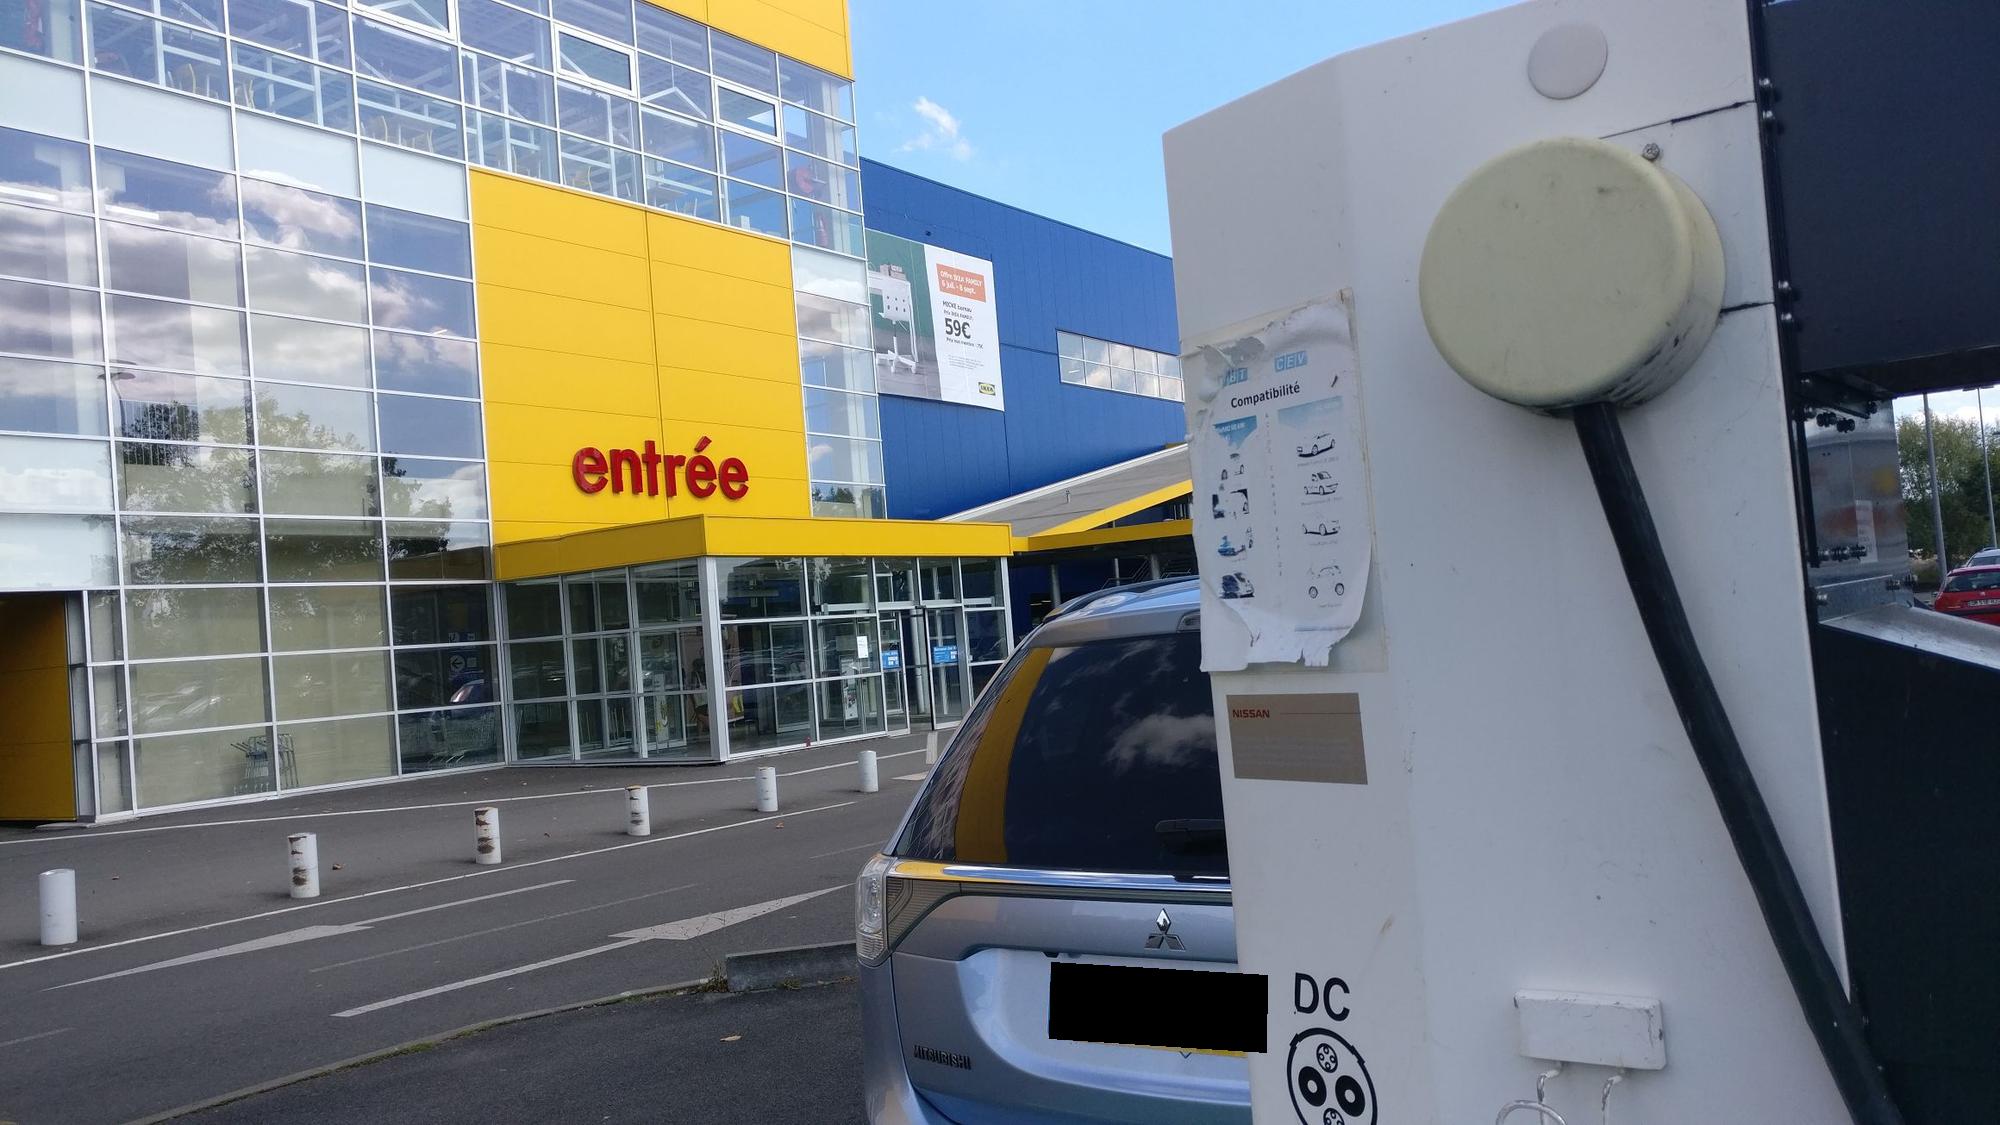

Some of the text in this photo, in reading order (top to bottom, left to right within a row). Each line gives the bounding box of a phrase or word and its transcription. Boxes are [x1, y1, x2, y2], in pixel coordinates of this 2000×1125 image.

[945, 317, 971, 339] 59€
[1231, 381, 1300, 408] Compatibilité
[572, 435, 749, 499] entrée
[1232, 709, 1270, 718] NISSAN
[1294, 972, 1350, 1022] DC
[913, 1044, 972, 1070] MITSUBISHI
